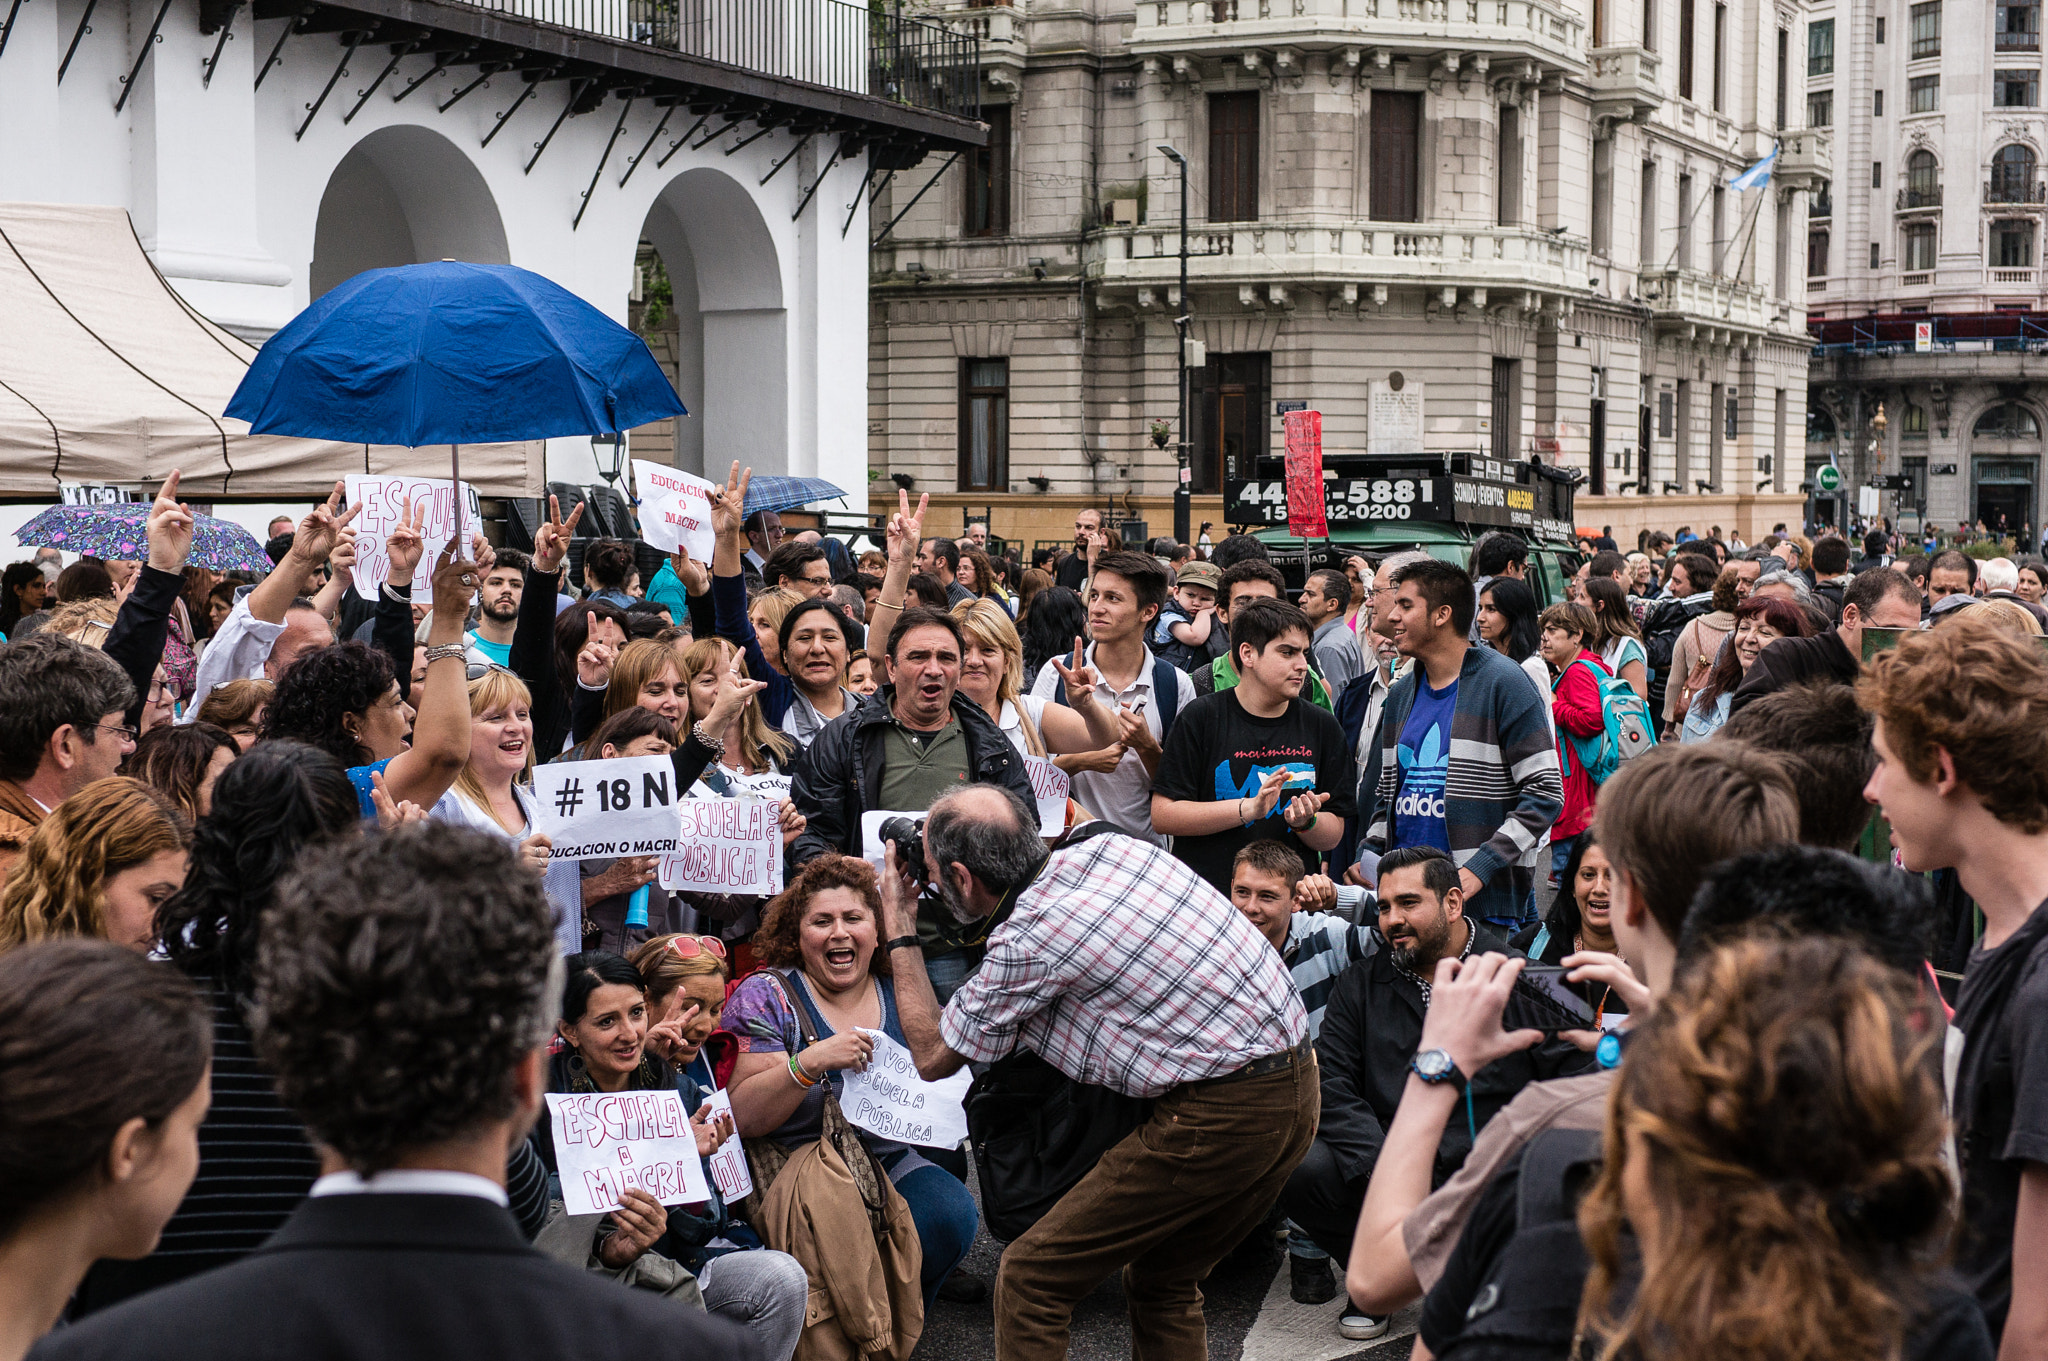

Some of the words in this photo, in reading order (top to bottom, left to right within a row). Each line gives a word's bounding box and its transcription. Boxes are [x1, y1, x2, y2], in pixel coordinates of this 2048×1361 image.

[651, 473, 708, 500] EDUCACIÓ
[1454, 482, 1477, 504] SONIDO
[359, 480, 475, 545] ESCUEL
[679, 499, 687, 510] O
[665, 512, 700, 531] MACRI
[1234, 745, 1313, 759] movimiento
[555, 778, 584, 817] #
[597, 779, 631, 812] 18
[643, 771, 669, 808] N
[680, 800, 762, 841] SCUELA
[548, 842, 616, 858] DUCACION
[619, 842, 629, 853] O
[634, 839, 677, 852] MACRI
[884, 1046, 918, 1079] VOT
[855, 1065, 925, 1109] SCUELA
[558, 1095, 686, 1148] ESCUELA
